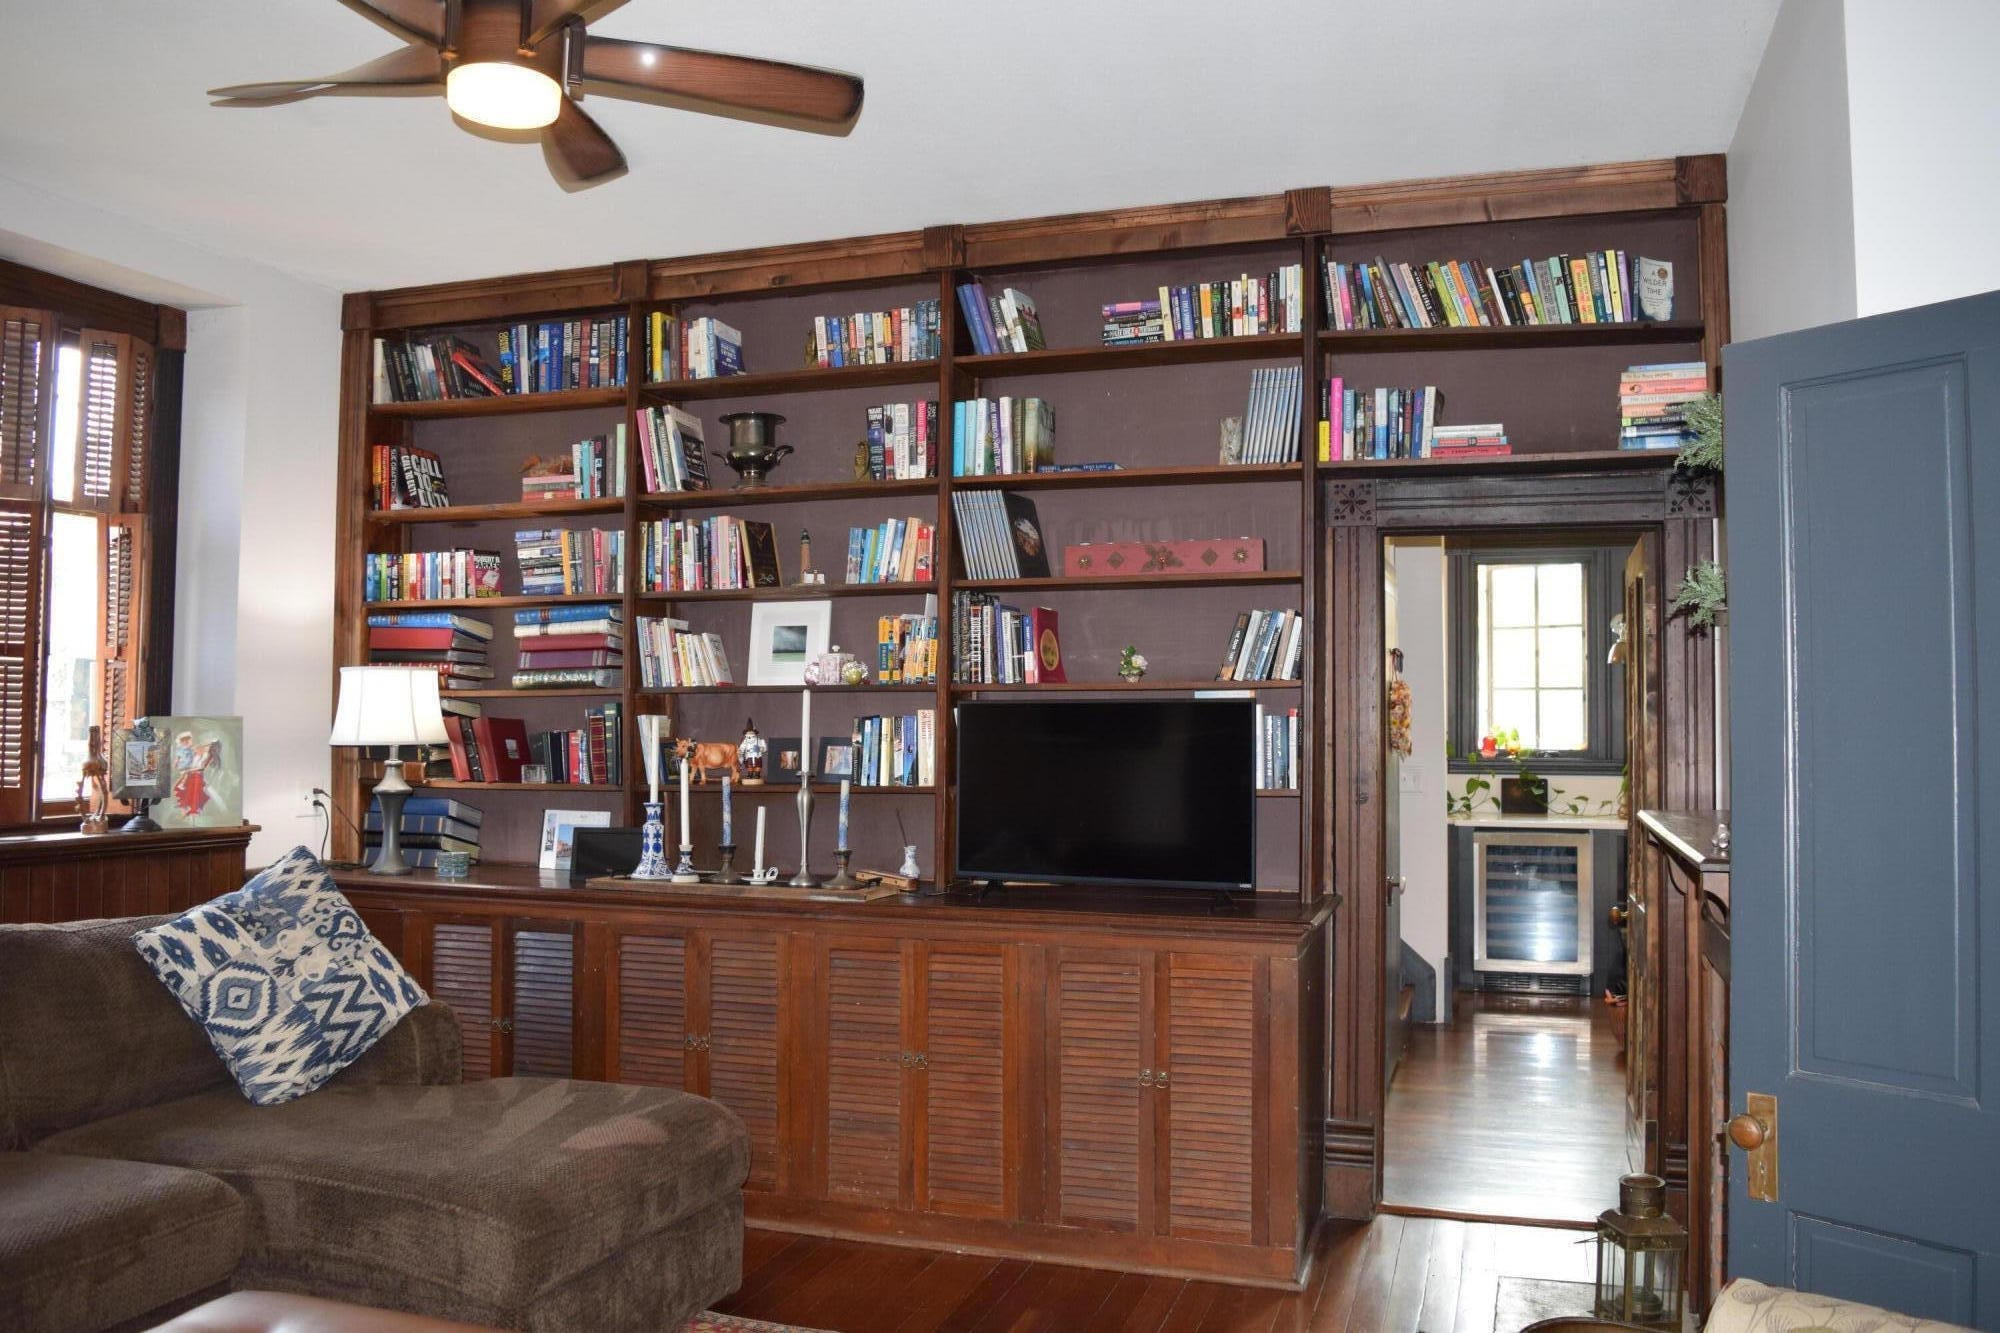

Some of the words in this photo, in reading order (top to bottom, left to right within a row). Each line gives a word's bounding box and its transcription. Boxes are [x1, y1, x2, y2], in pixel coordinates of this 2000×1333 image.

[1642, 275, 1667, 287] WILDER
[1647, 287, 1663, 296] TIME
[1380, 298, 1388, 312] CODE
[401, 455, 412, 472] CALL
[411, 454, 443, 478] CALL
[414, 470, 432, 492] TO
[418, 488, 449, 508] DUTY
